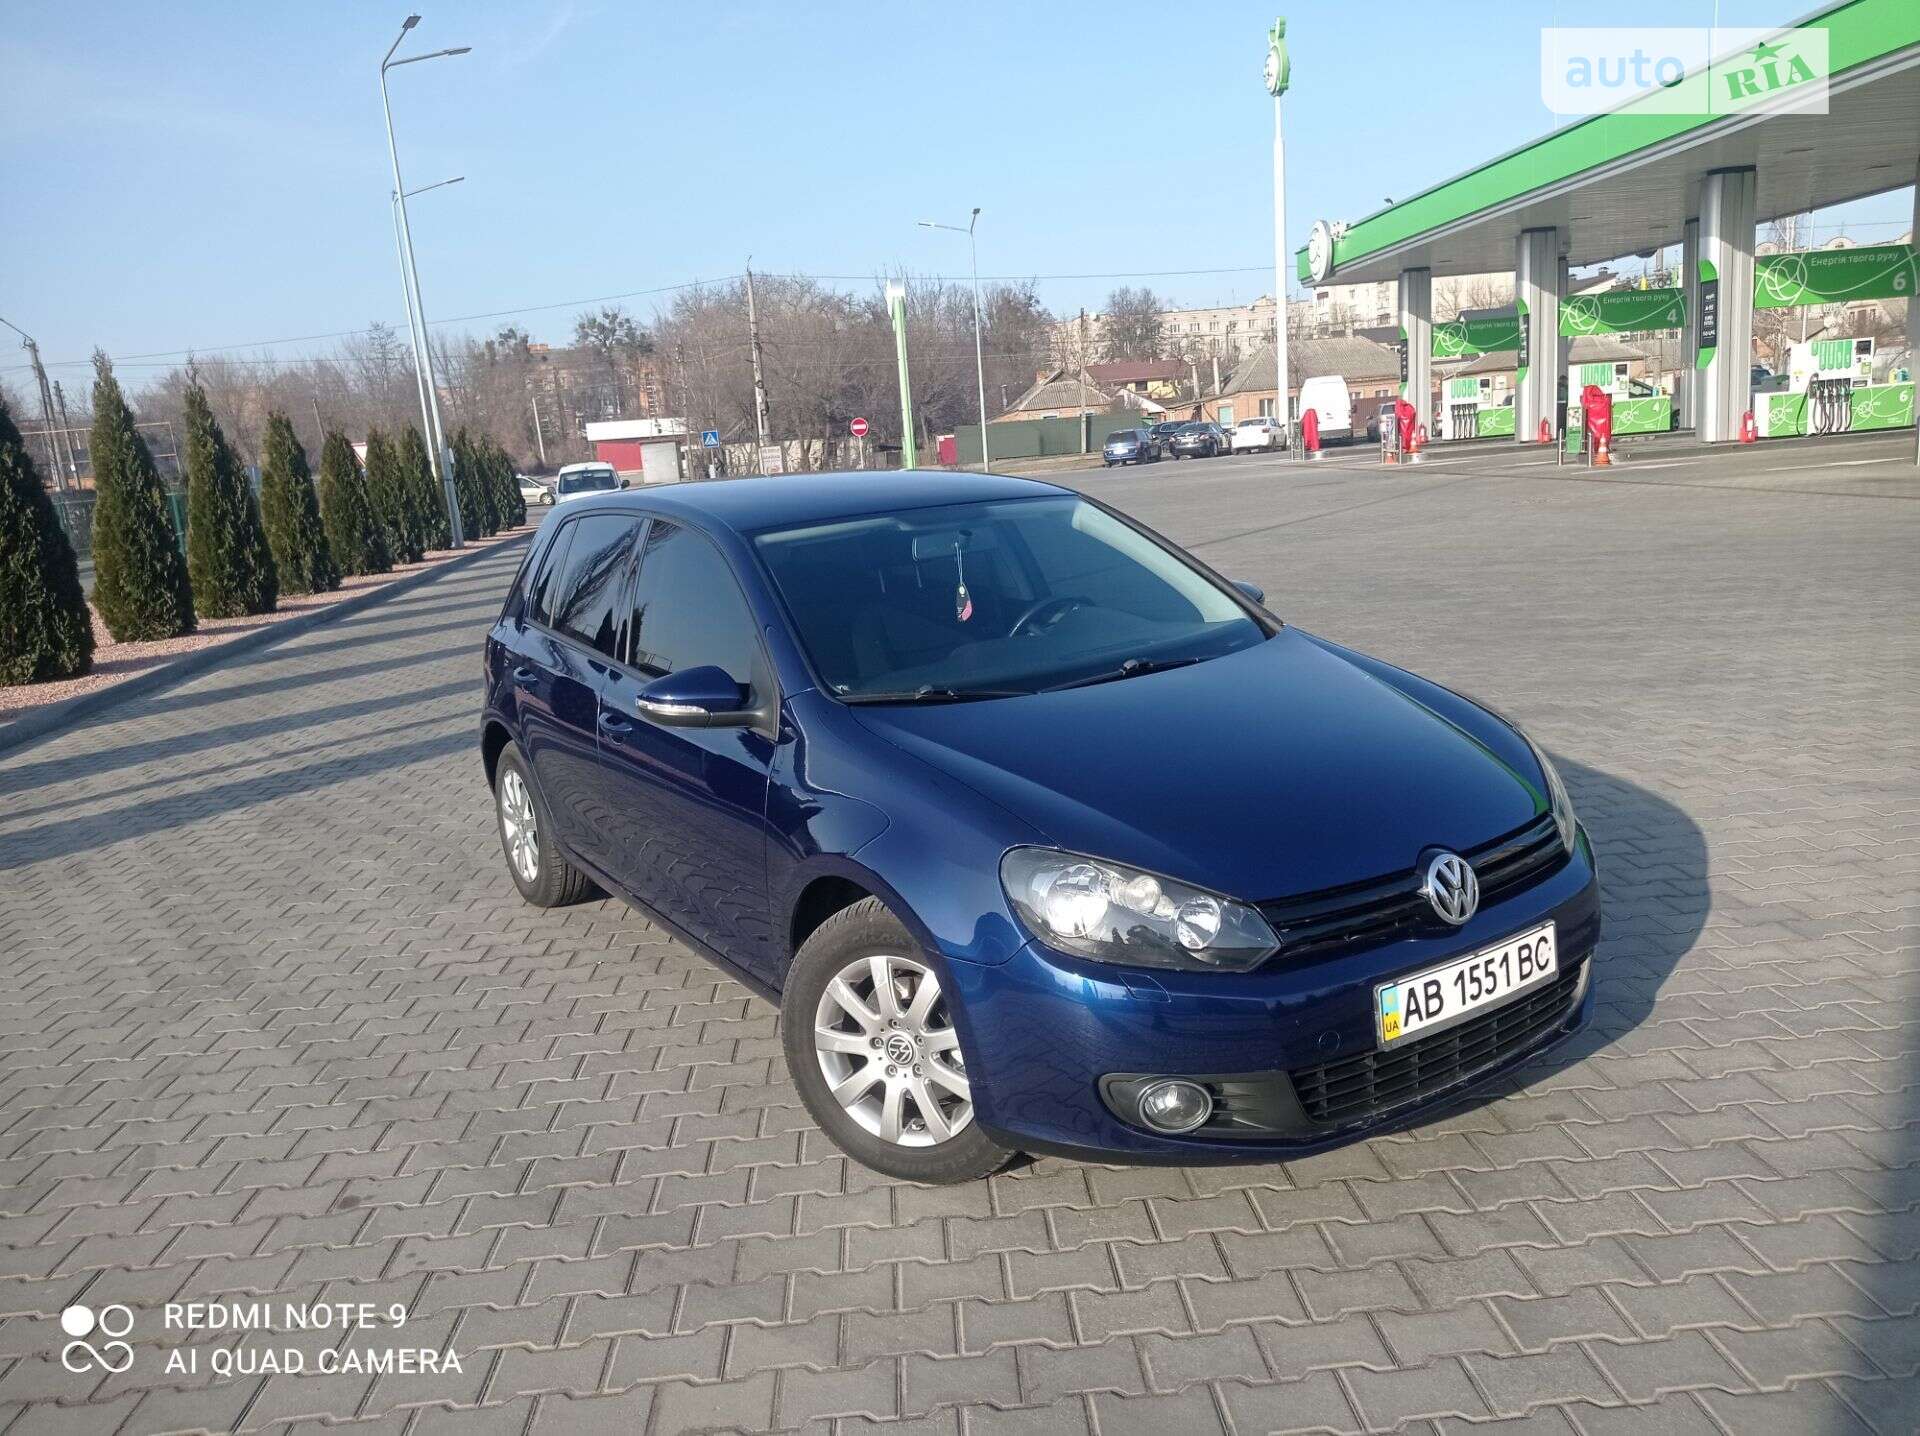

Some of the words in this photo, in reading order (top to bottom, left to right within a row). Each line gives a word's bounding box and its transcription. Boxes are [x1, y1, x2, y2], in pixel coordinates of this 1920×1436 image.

[1811, 254, 1846, 267] Енергія
[1849, 254, 1875, 264] твого
[1877, 252, 1899, 263] руху
[1893, 271, 1907, 291] 6
[1667, 308, 1677, 323] 4
[1899, 390, 1908, 402] 6
[1404, 979, 1444, 1027] AB
[1454, 952, 1511, 1006] 1551
[1518, 936, 1550, 982] BC
[1386, 1019, 1399, 1033] UA
